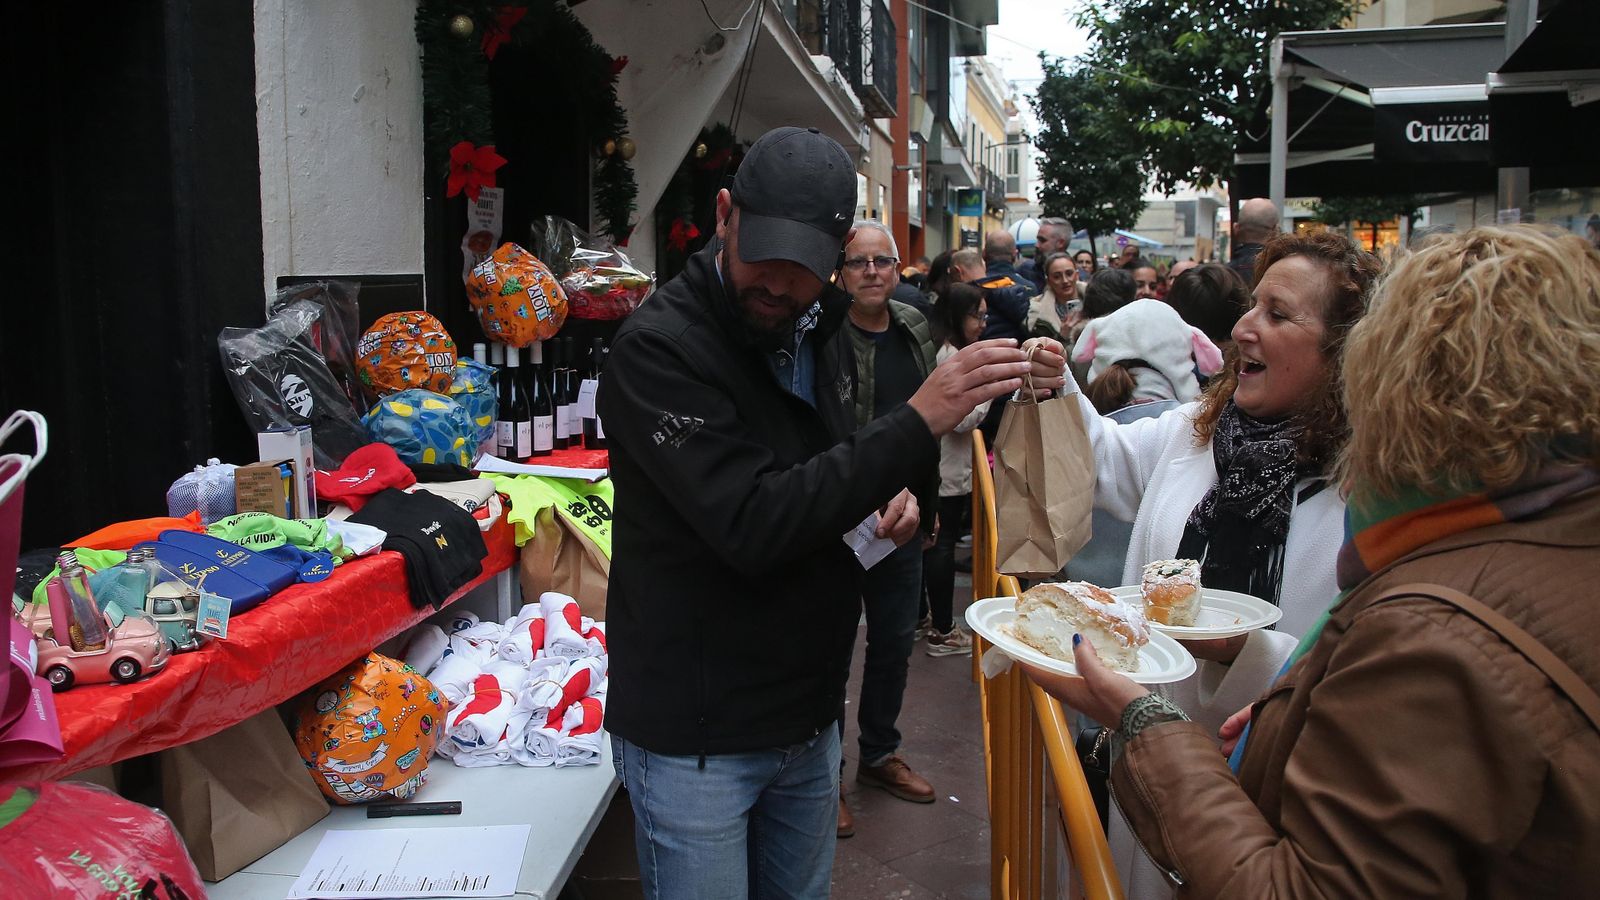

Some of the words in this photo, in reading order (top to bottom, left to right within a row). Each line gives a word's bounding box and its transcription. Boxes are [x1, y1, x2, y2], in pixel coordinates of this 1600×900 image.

[426, 353, 452, 366] TOY
[240, 536, 251, 546] LA
[253, 533, 276, 544] VIDA
